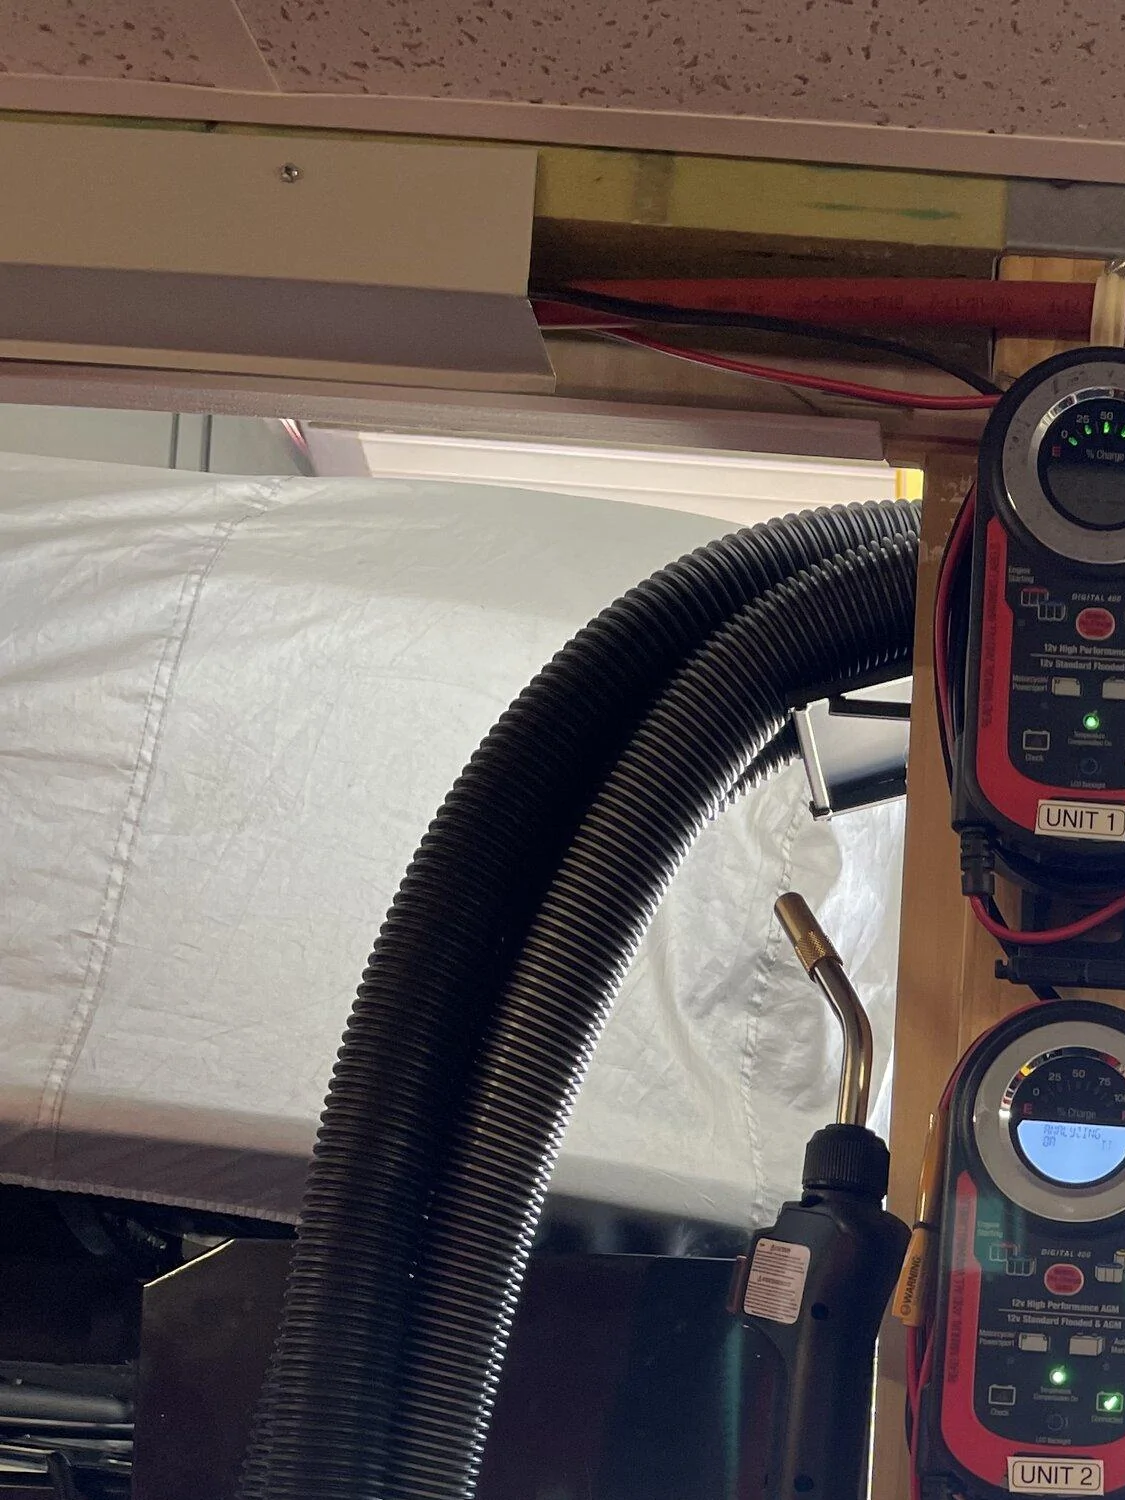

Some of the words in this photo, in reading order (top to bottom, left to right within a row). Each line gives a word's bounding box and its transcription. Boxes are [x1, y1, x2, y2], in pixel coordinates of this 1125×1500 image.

[1076, 415, 1090, 424] 25
[1100, 412, 1114, 420] 50
[1060, 430, 1068, 439] 0
[1086, 449, 1094, 460] %
[1096, 450, 1125, 462] Charge
[1072, 593, 1105, 602] DIGITAL
[1044, 643, 1057, 652] 12v
[1060, 644, 1077, 655] High
[1040, 658, 1053, 668] 12v
[1055, 659, 1091, 670] Standard
[1094, 660, 1124, 671] Flooded
[1046, 808, 1098, 828] UNIT
[1107, 813, 1114, 831] 1
[1049, 1073, 1061, 1081] 25
[1073, 1069, 1085, 1078] 50
[1099, 1077, 1111, 1086] 75
[1033, 1088, 1040, 1096] 0
[1024, 1104, 1032, 1114] E
[1068, 1109, 1096, 1119] Charge
[1041, 1248, 1074, 1257] DIGITAL
[1077, 1250, 1091, 1258] 400
[904, 1256, 921, 1304] WARNING
[1012, 1299, 1025, 1308] 12v
[1027, 1300, 1045, 1310] High
[1047, 1302, 1098, 1312] Performance
[1100, 1304, 1120, 1313] AGM
[1007, 1314, 1021, 1323] 12v
[1022, 1315, 1059, 1326] Standard
[1061, 1317, 1093, 1327] Flooded
[1094, 1319, 1101, 1327] &
[1103, 1320, 1122, 1329] AGM
[1020, 1466, 1076, 1484] UNIT
[1080, 1467, 1093, 1486] 2
